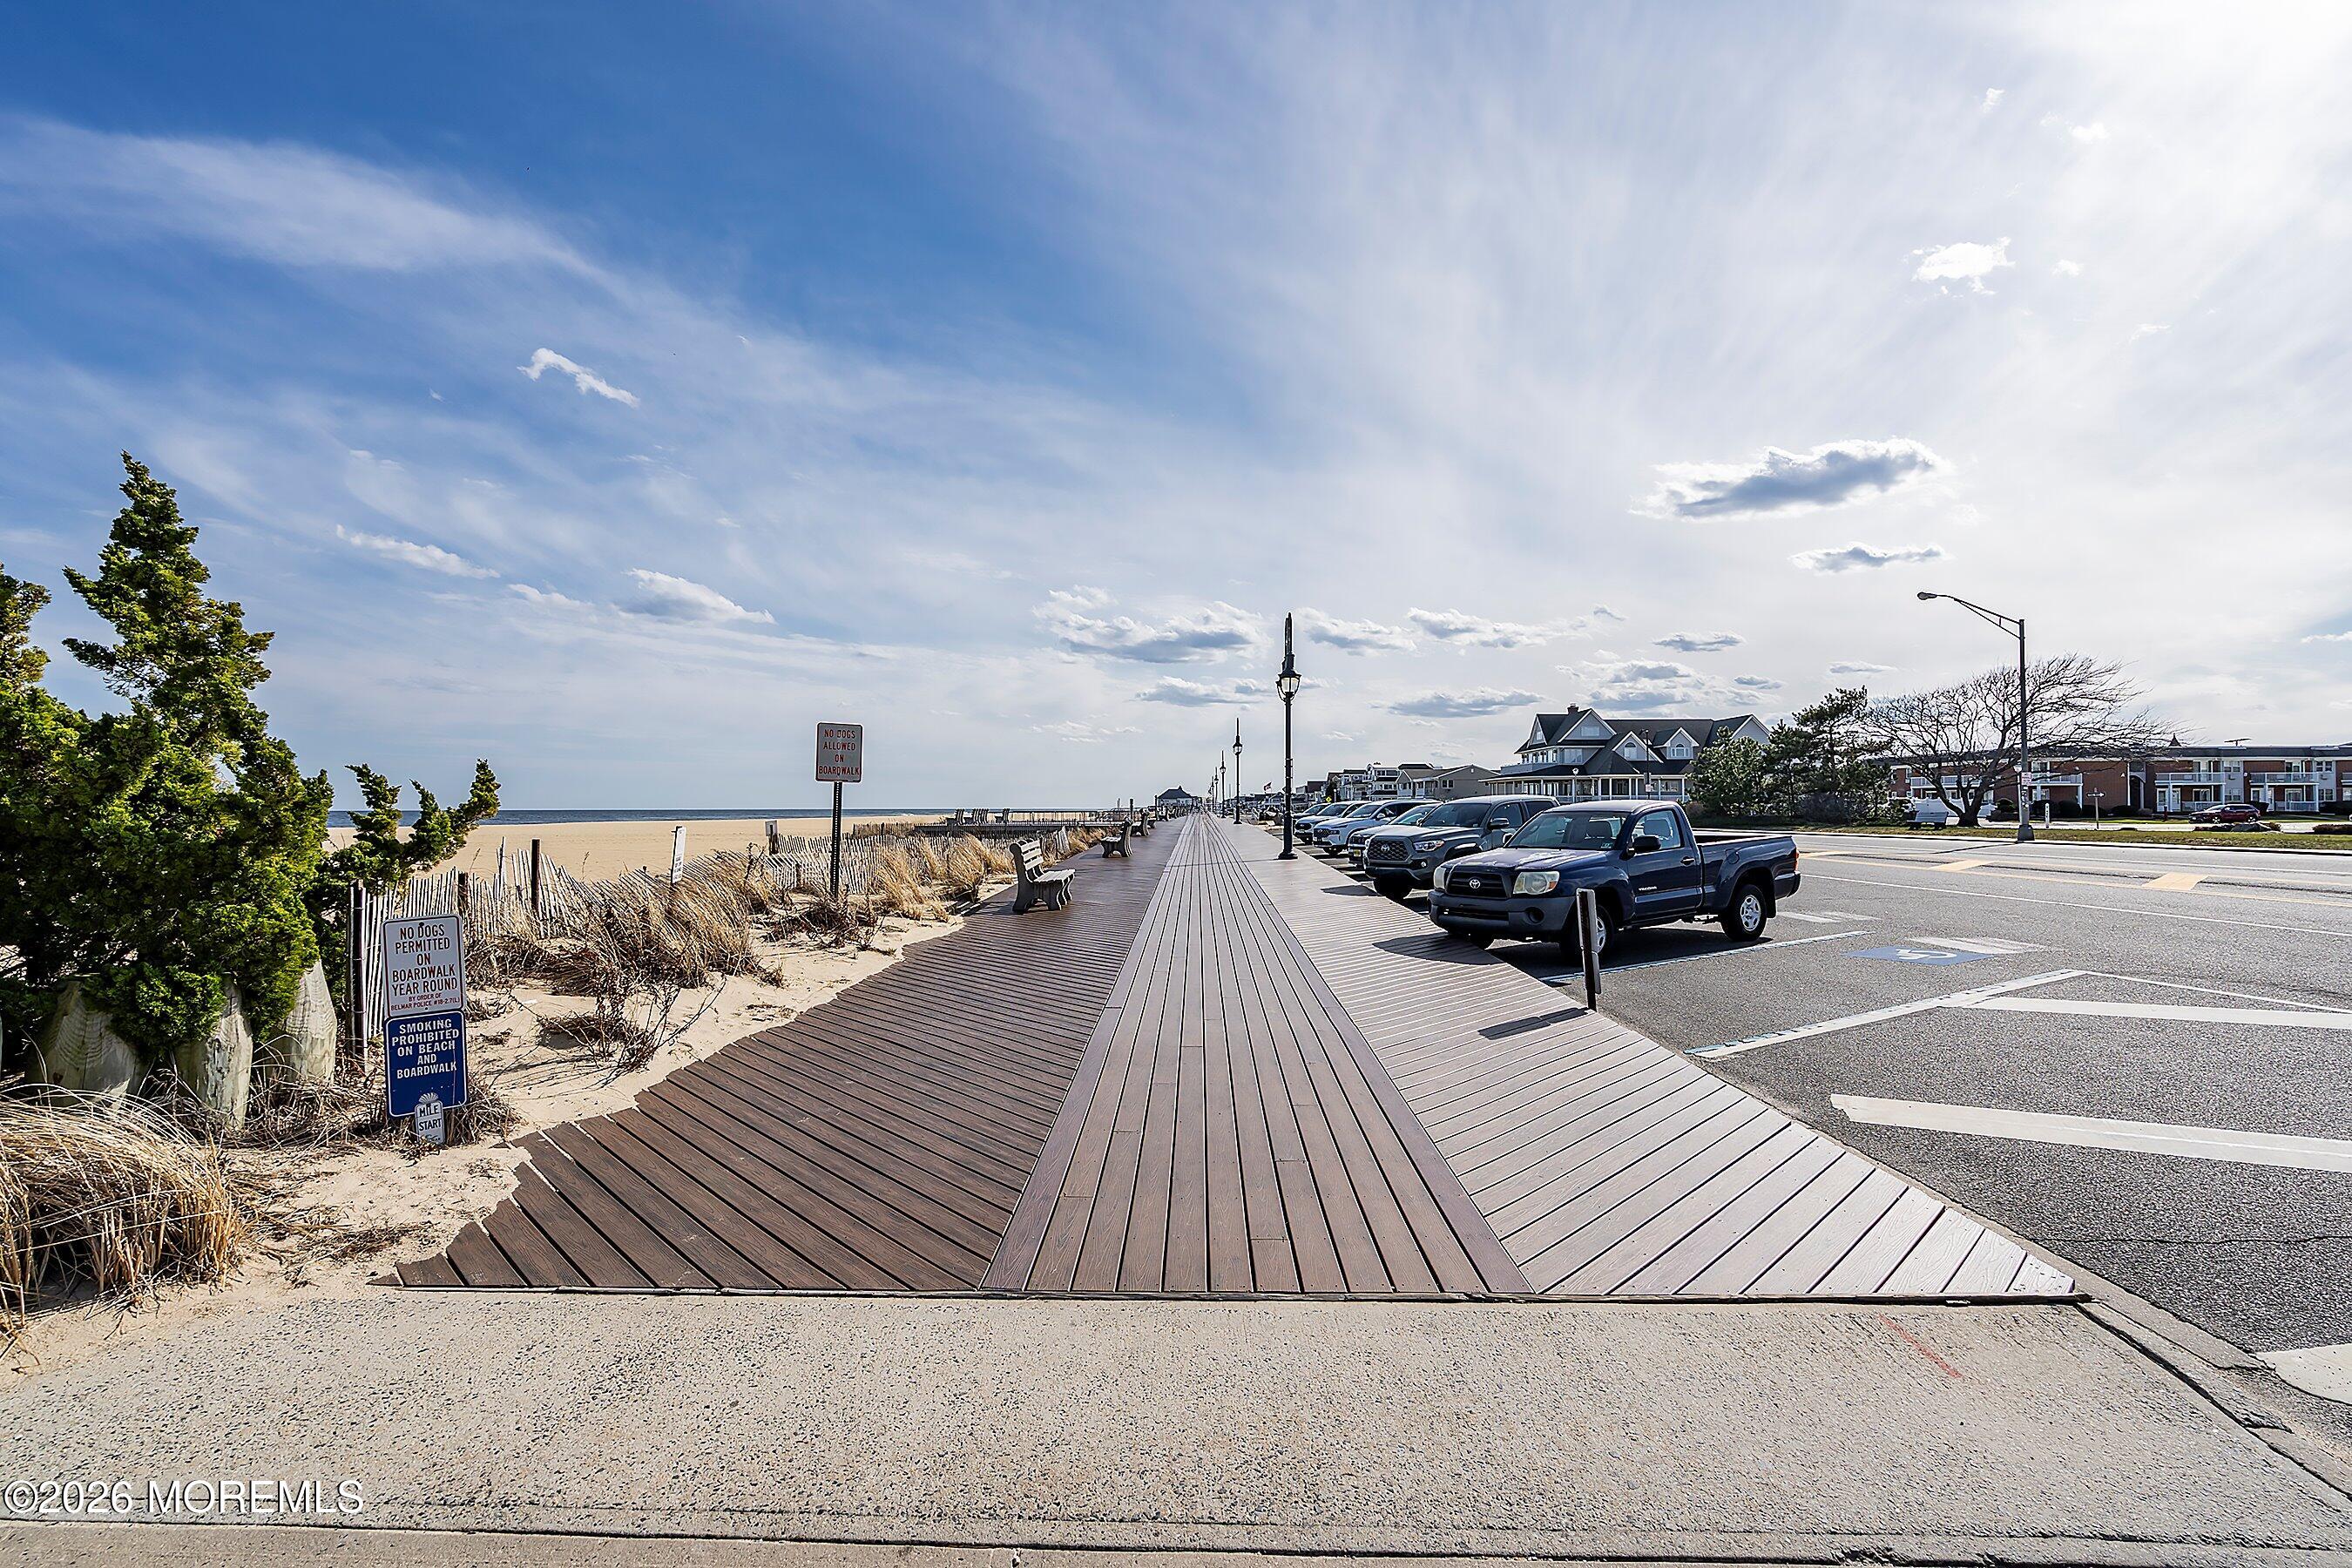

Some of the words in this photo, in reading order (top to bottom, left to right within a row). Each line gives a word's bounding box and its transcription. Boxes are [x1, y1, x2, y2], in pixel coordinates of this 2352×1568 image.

[824, 729, 834, 738] NO
[837, 730, 856, 739] DOGS
[823, 741, 856, 751] ALLOWED
[835, 754, 844, 763] ON
[819, 766, 860, 775] BOARDWALK
[400, 926, 415, 940] NO
[418, 923, 445, 938] DOGS
[395, 936, 450, 954] PERMITTED
[416, 952, 431, 966] ON
[392, 963, 456, 983] BOARDWALK
[391, 982, 419, 997] YEAR
[423, 977, 458, 993] ROUND
[399, 1018, 452, 1034] SMOKING
[391, 1029, 460, 1046] PROHIBITED
[397, 1045, 413, 1057] ON
[418, 1040, 456, 1054] BEACH
[417, 1053, 437, 1065] AND
[396, 1061, 457, 1079] BOARDWALK
[419, 1104, 440, 1117] MILE
[418, 1118, 442, 1132] START
